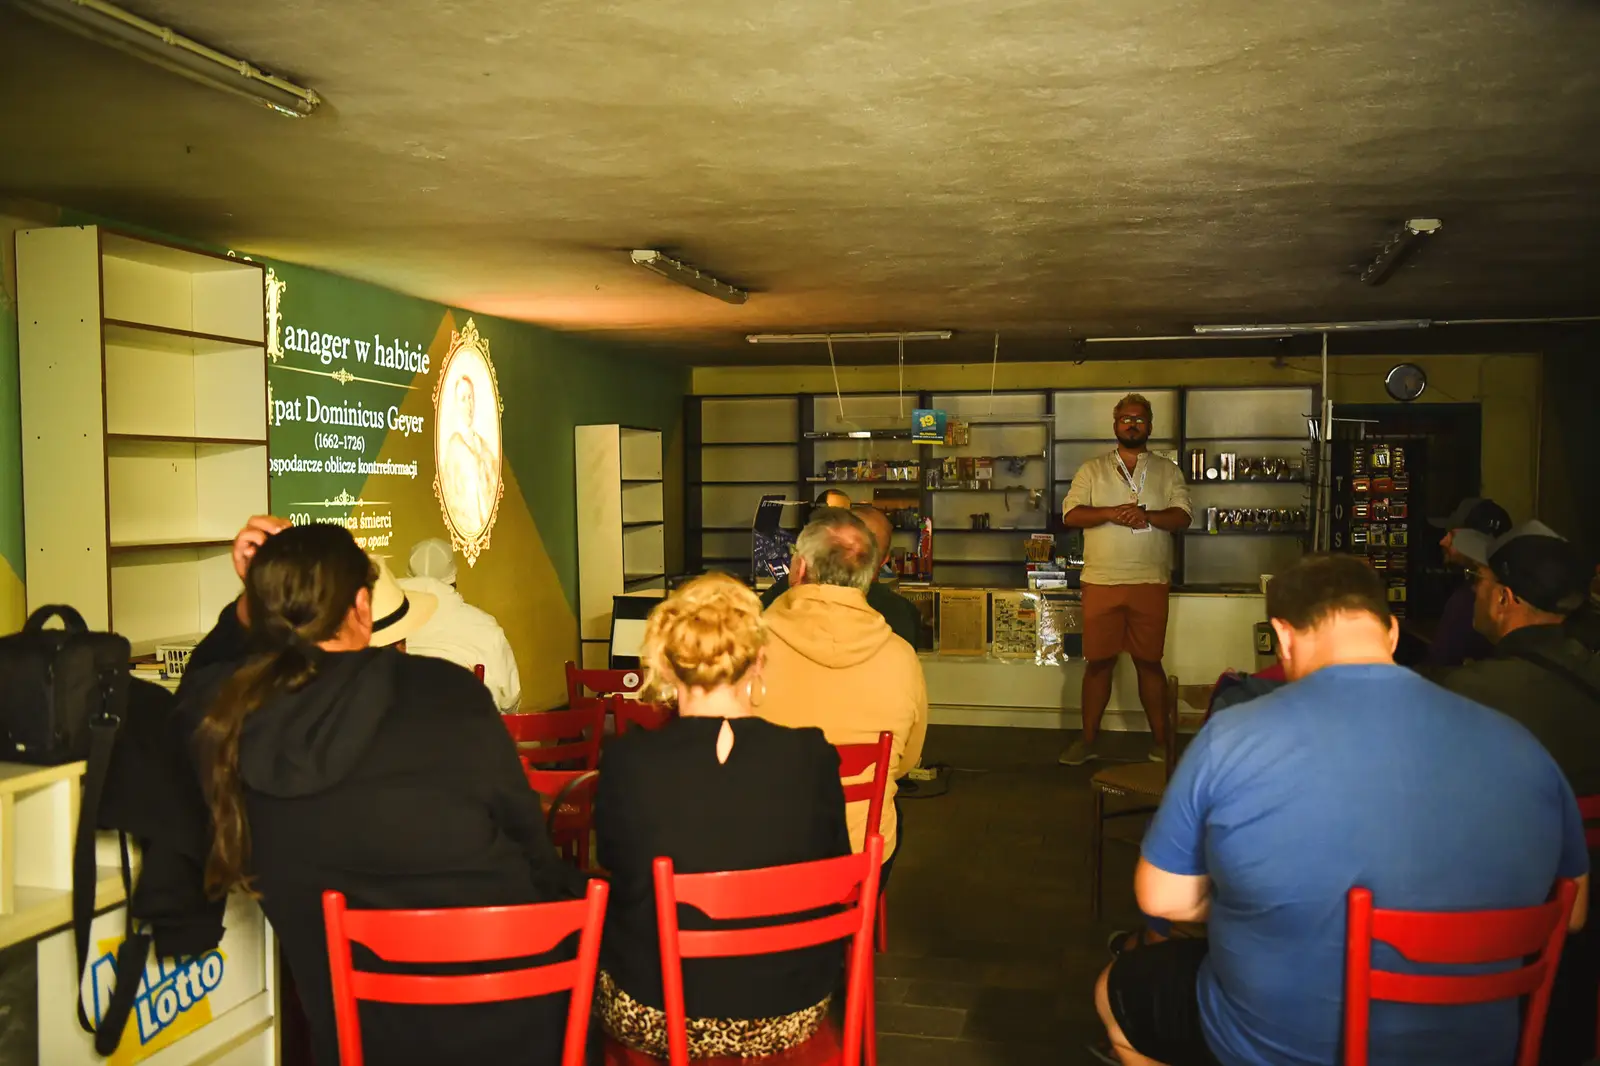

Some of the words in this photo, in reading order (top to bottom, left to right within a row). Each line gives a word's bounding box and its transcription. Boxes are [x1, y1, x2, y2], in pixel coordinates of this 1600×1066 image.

[354, 339, 370, 363] w
[374, 334, 430, 375] habicie
[306, 395, 384, 429] Dominicus
[387, 406, 424, 437] Geyer
[269, 453, 323, 476] ospodarcze
[324, 455, 356, 473] oblicze
[358, 458, 418, 479] kontrreformacji
[360, 511, 392, 529] śmierci
[136, 951, 223, 1045] Lotto
